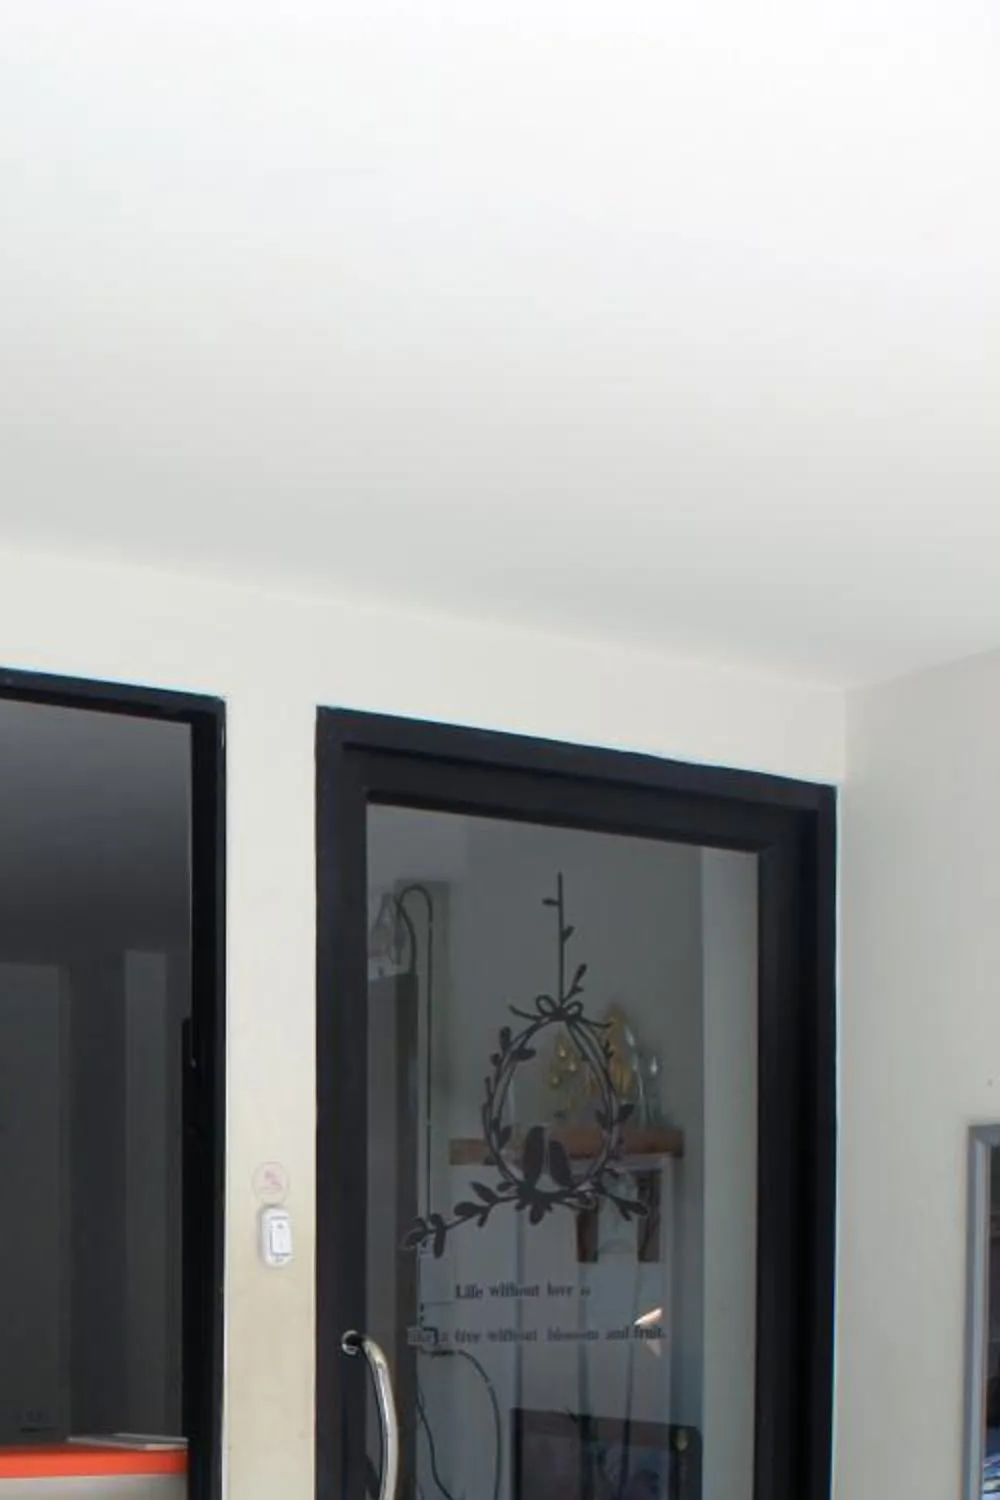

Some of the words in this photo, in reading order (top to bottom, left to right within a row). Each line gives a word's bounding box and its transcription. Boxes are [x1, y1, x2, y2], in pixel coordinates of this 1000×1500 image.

[455, 1283, 483, 1299] Life
[488, 1281, 540, 1297] without
[546, 1280, 574, 1296] love
[487, 1327, 538, 1342] without
[605, 1325, 630, 1341] and
